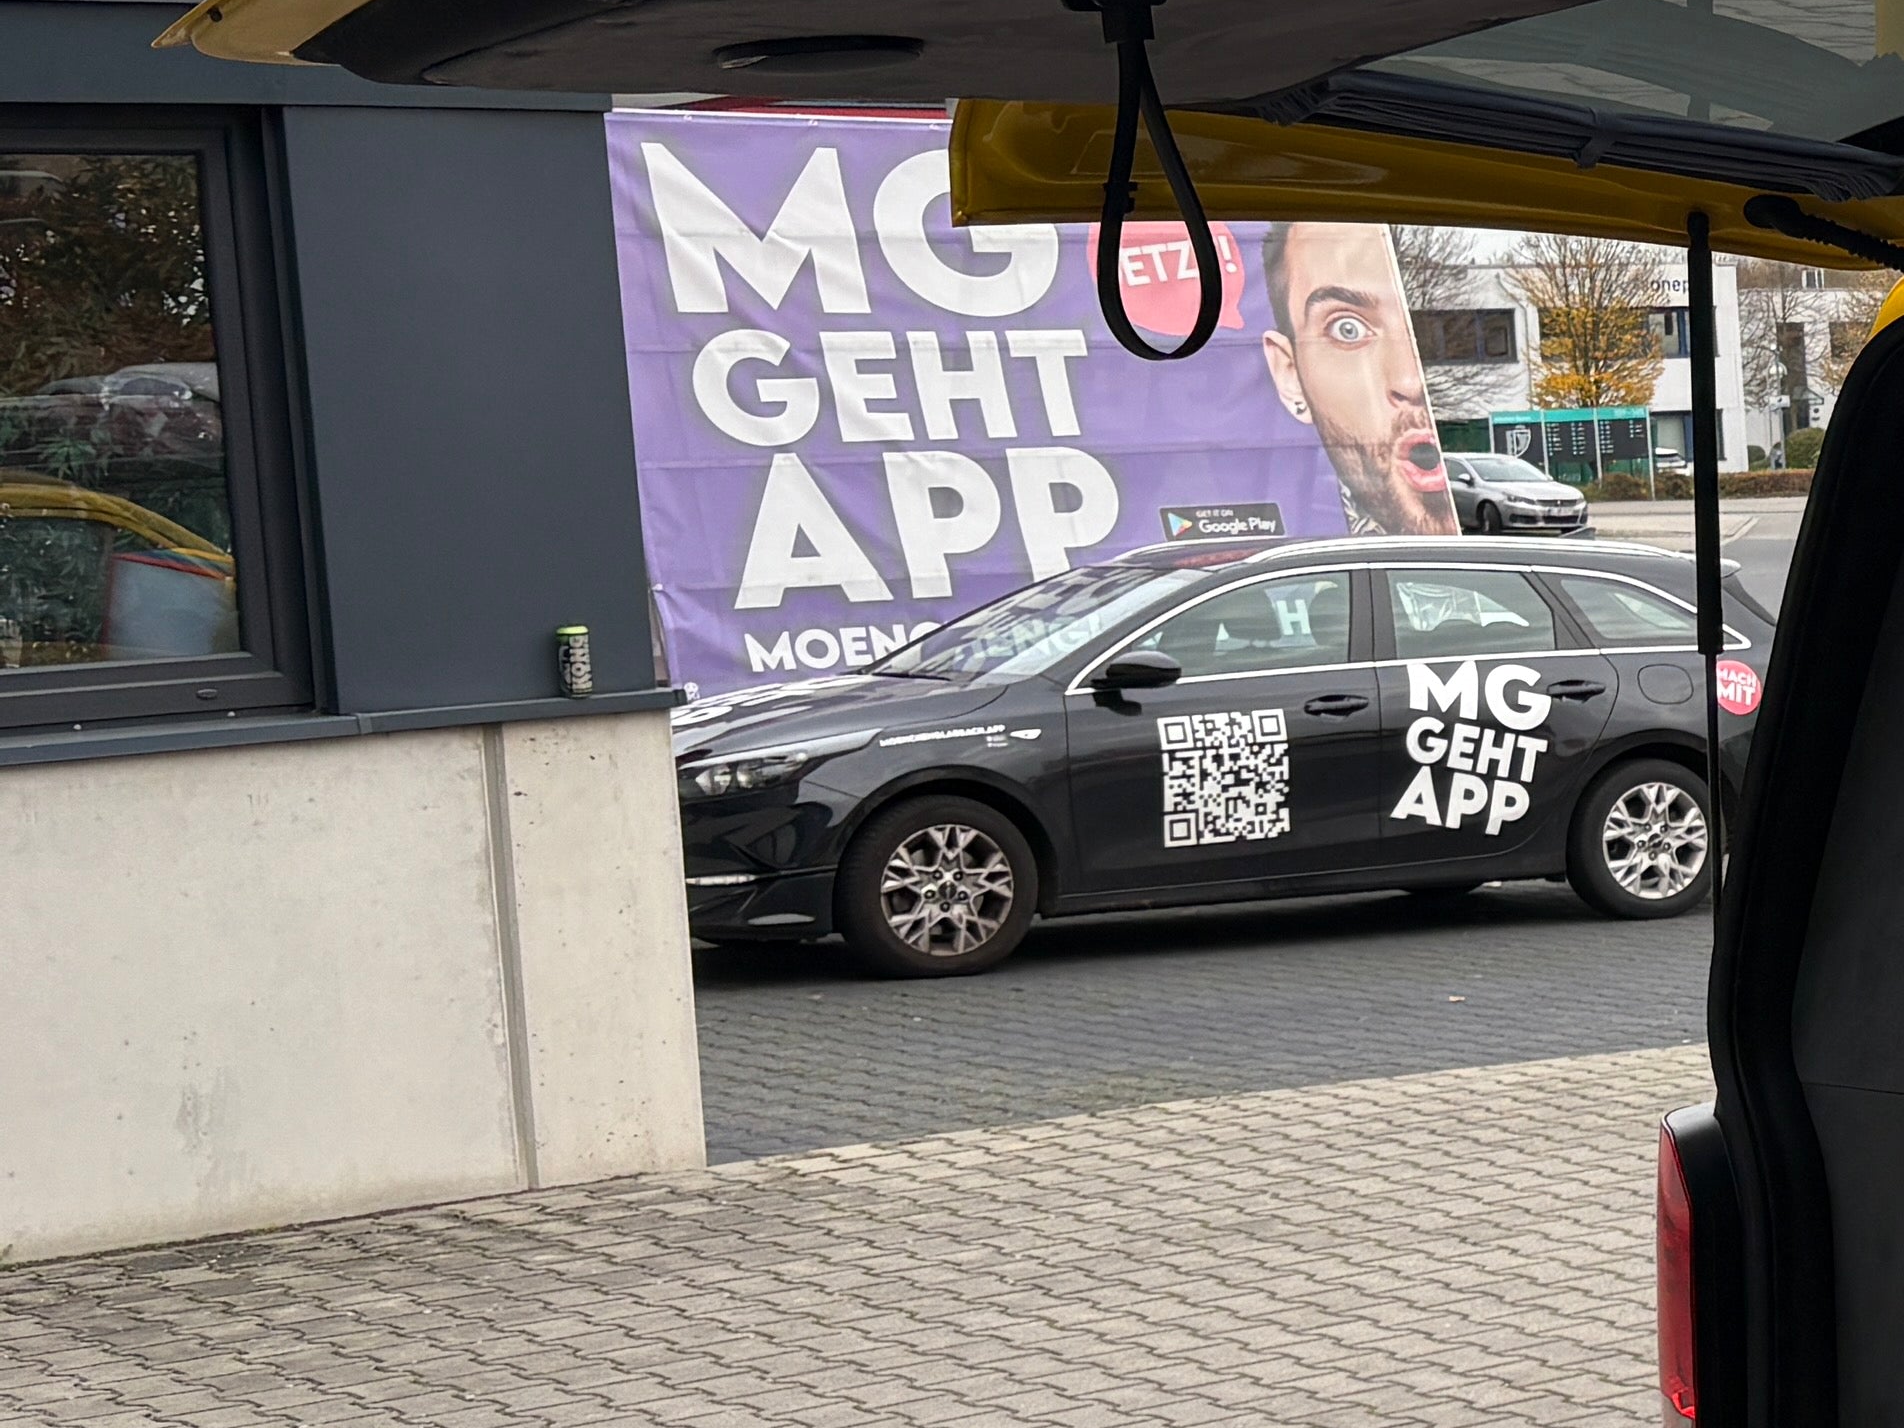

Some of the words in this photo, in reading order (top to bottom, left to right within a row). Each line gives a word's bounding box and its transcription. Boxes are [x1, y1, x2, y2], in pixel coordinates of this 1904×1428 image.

[641, 141, 1060, 318] MG
[1119, 235, 1238, 287] ETZ!
[692, 328, 1088, 446] GEHT
[734, 446, 1120, 610] APP
[1199, 518, 1249, 535] Google
[1248, 517, 1276, 533] Play
[1406, 659, 1552, 731] MG
[1717, 680, 1756, 707] MIT
[1405, 716, 1548, 783] GEHT
[1389, 765, 1531, 836] APP
